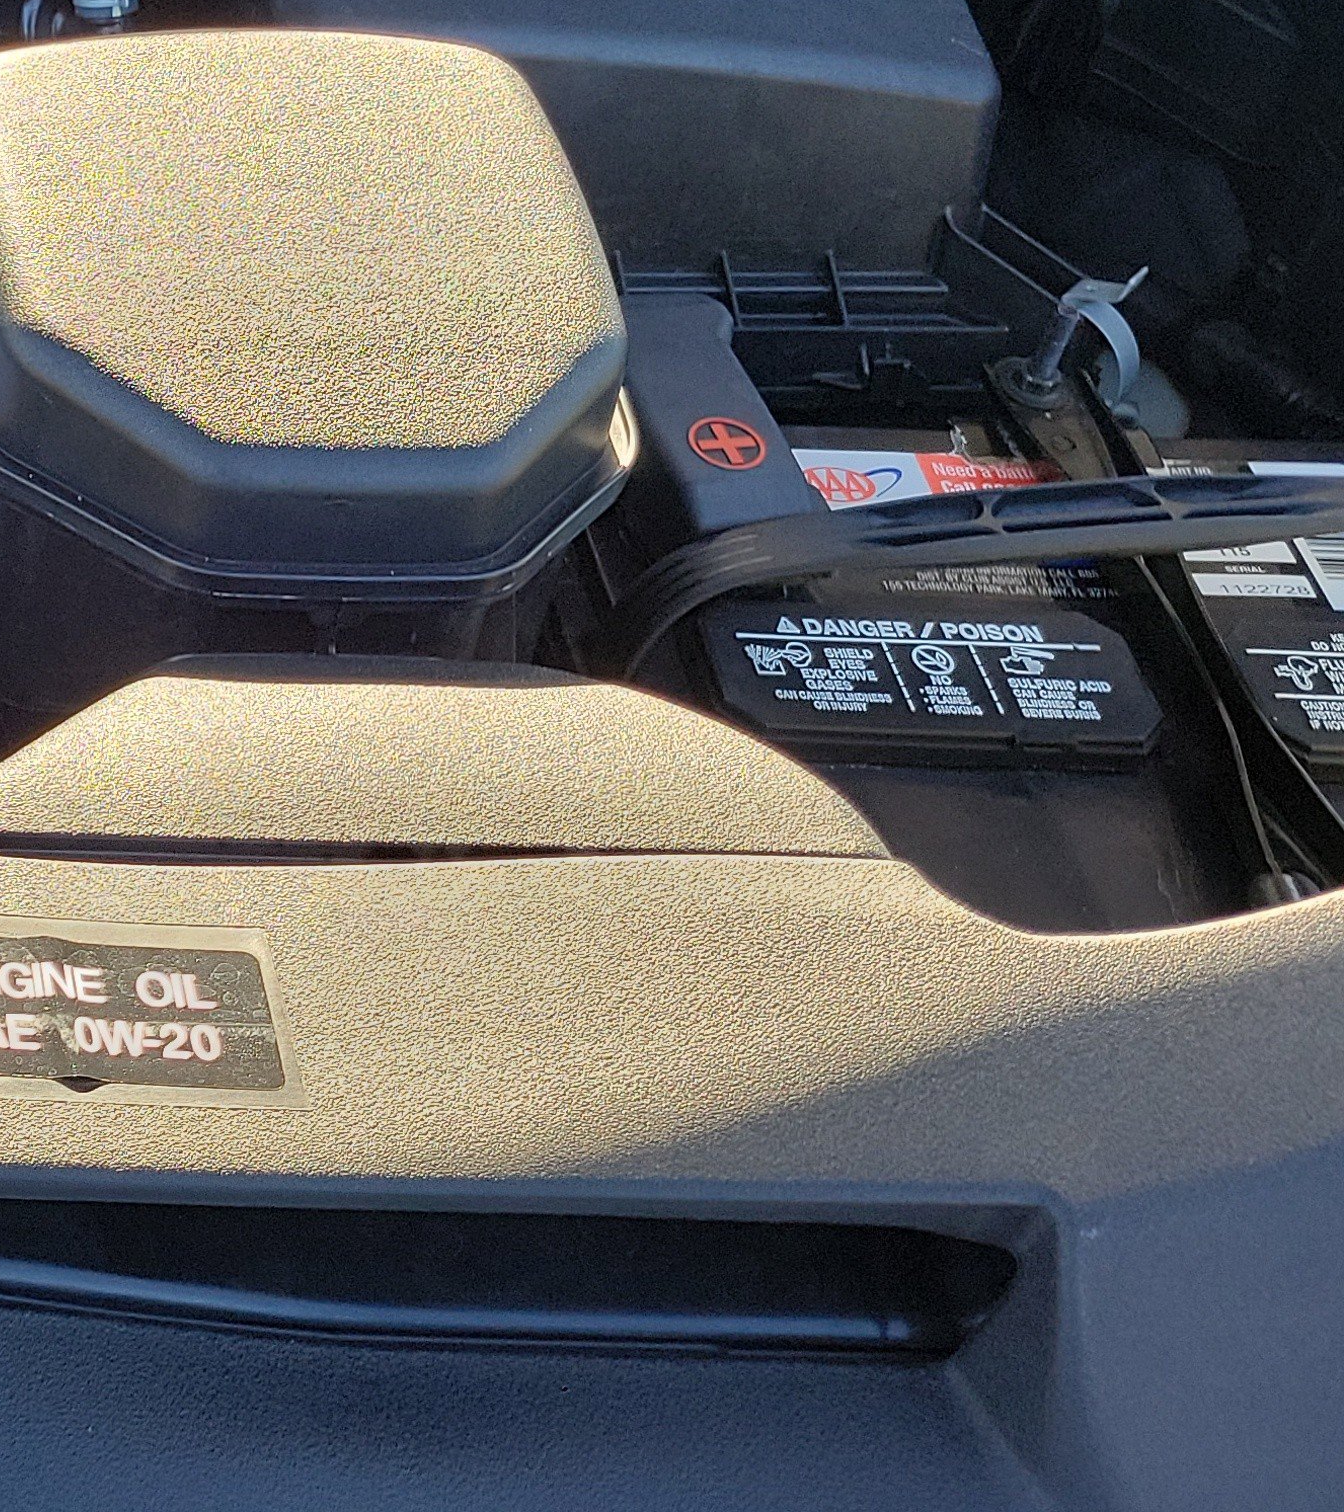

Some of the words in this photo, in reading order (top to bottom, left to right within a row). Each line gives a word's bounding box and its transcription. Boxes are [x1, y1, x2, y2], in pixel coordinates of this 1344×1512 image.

[932, 462, 977, 477] Need
[981, 466, 993, 478] a
[940, 479, 976, 493] Call
[1224, 564, 1266, 574] SERIAL
[802, 618, 916, 638] DANGER
[939, 622, 1044, 643] POISON
[1310, 640, 1329, 651] DO
[823, 647, 874, 660] SHIELD
[828, 659, 866, 670] EYES
[799, 667, 879, 682] EXPLOSIVE
[931, 675, 953, 686] NO
[805, 679, 854, 691] GASES
[1006, 677, 1077, 692] SULFURIC
[1078, 680, 1113, 693] ACID
[775, 689, 799, 701] CAN
[800, 690, 834, 702] CAUSE
[1011, 688, 1037, 699] CAN
[1039, 689, 1077, 701] CAUSE
[934, 705, 984, 717] SMOKING
[1020, 707, 1064, 720] SEVERE
[135, 970, 220, 1010] OIL
[73, 1015, 225, 1062] 0W-20
